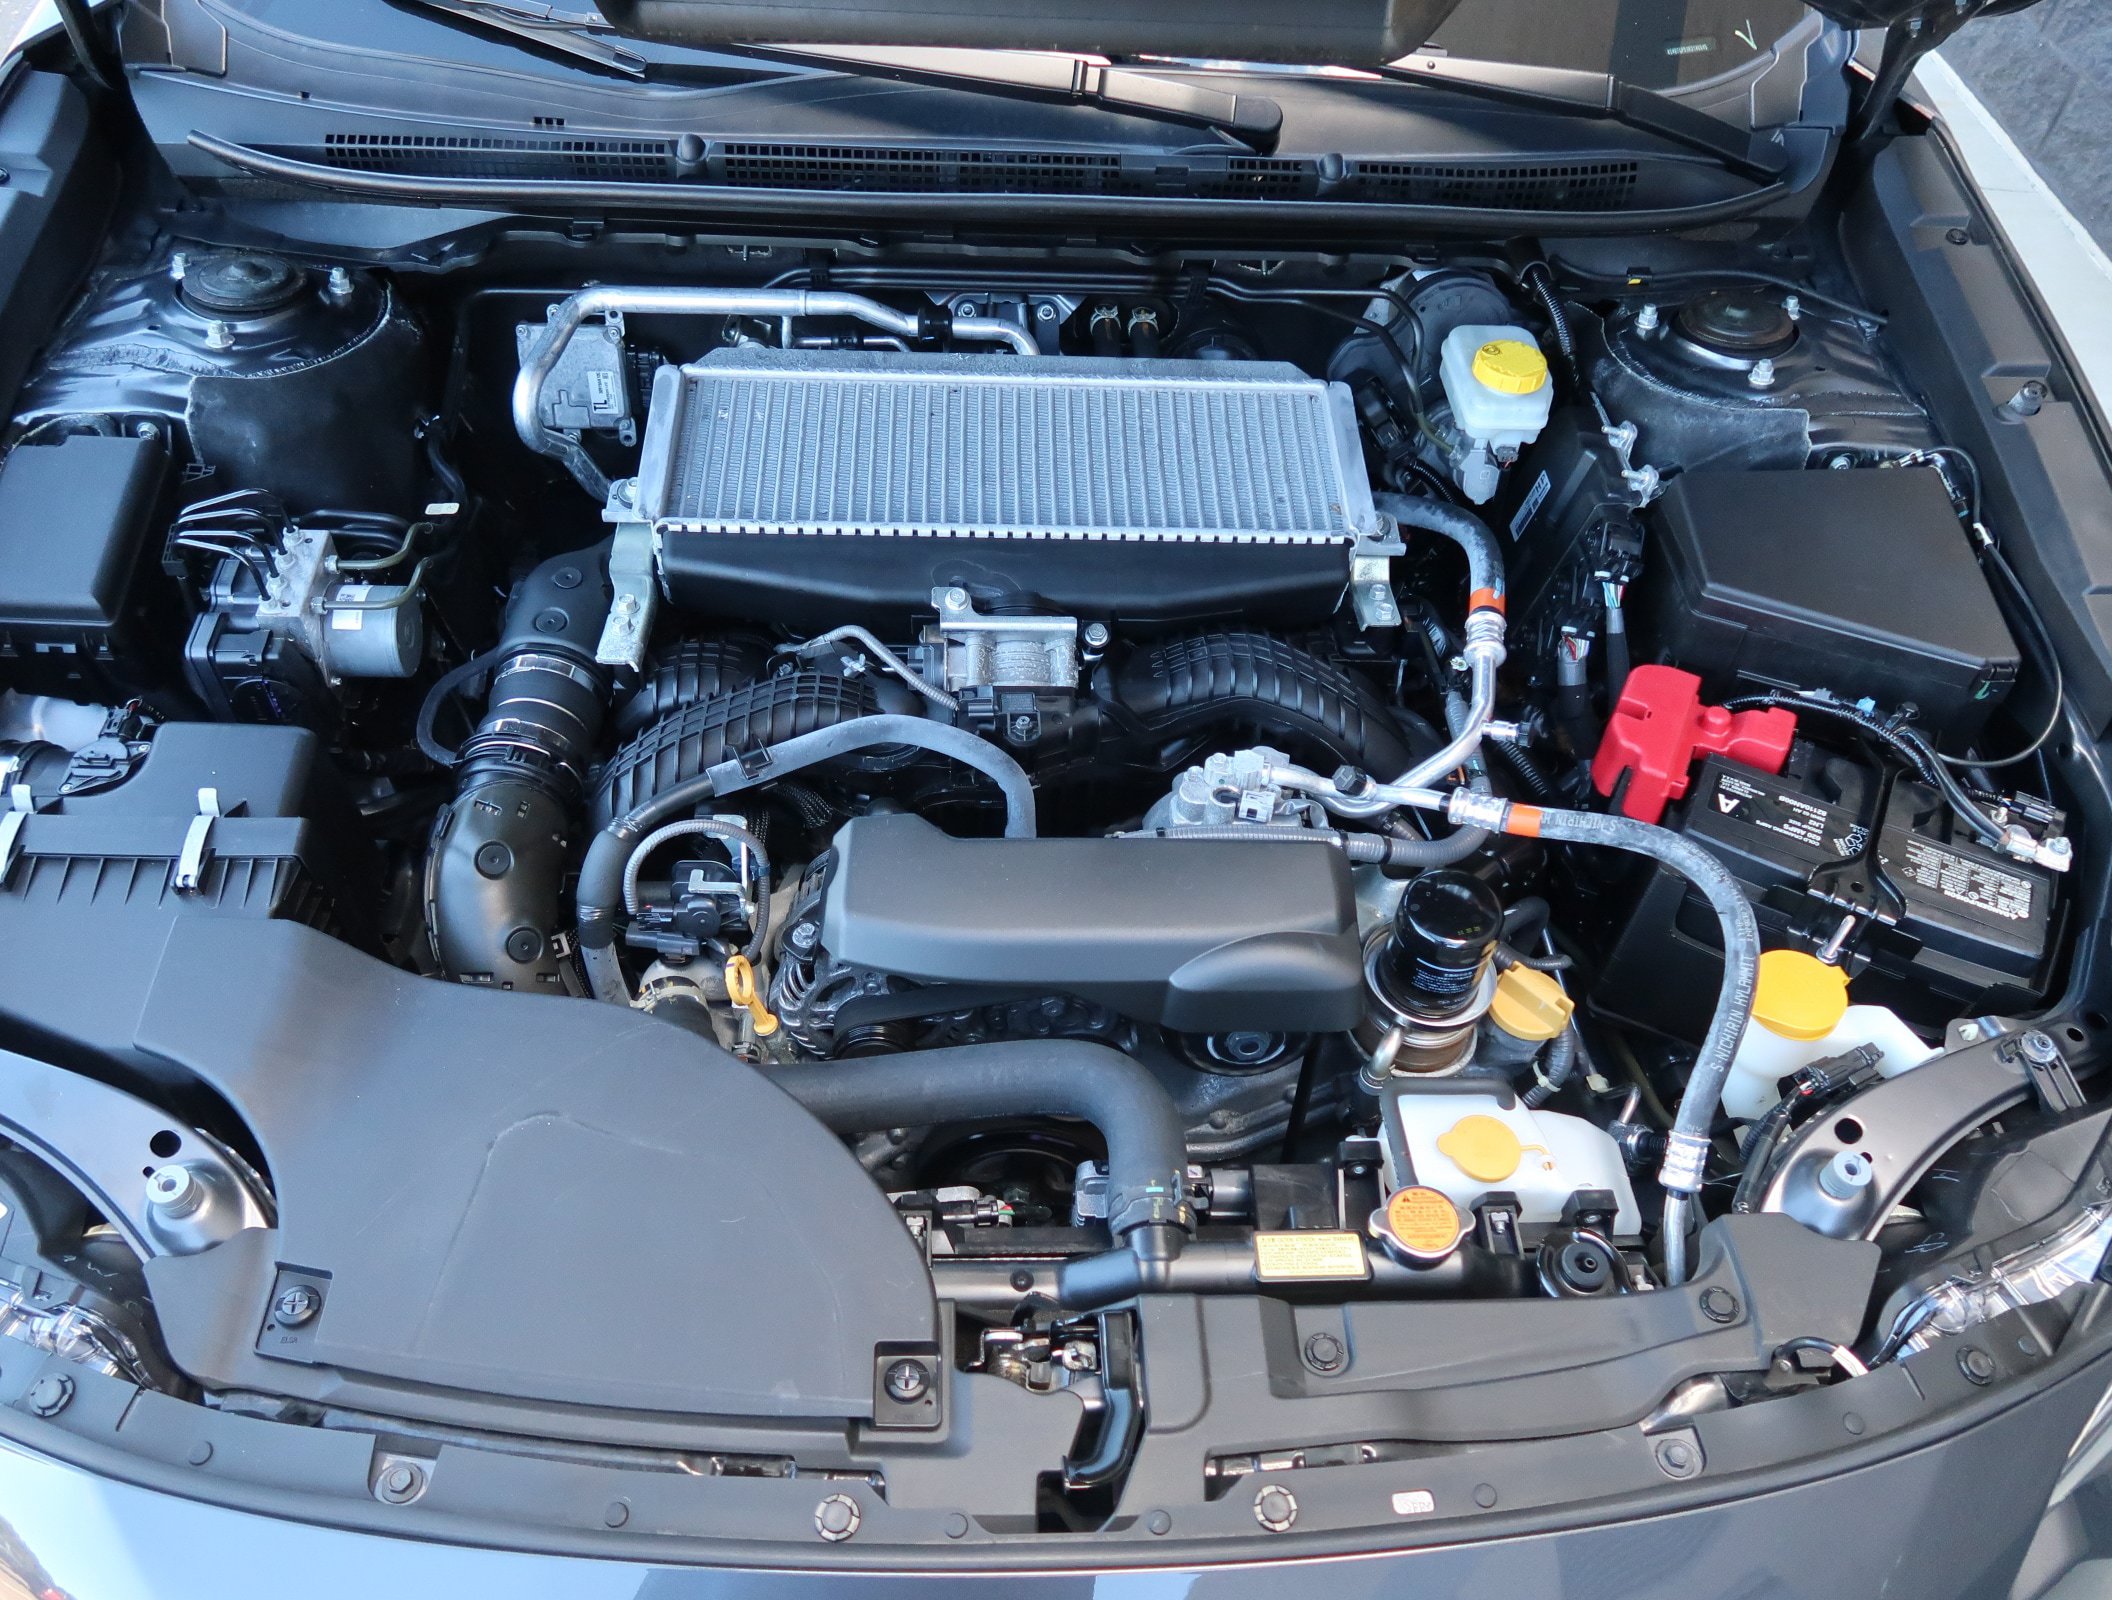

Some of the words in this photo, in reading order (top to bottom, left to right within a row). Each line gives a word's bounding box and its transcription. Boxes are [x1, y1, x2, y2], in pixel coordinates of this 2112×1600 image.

[593, 400, 608, 411] TL
[1535, 474, 1546, 492] HP
[1718, 793, 1740, 813] A
[1754, 819, 1772, 828] AMPS
[1787, 817, 1801, 826] SIZE
[1772, 825, 1803, 840] CRANKING
[1782, 822, 1806, 835] AMPS
[1801, 822, 1822, 834] GROUP
[1802, 836, 1820, 846] COLD
[1733, 953, 1755, 1006] HYLAMMIT
